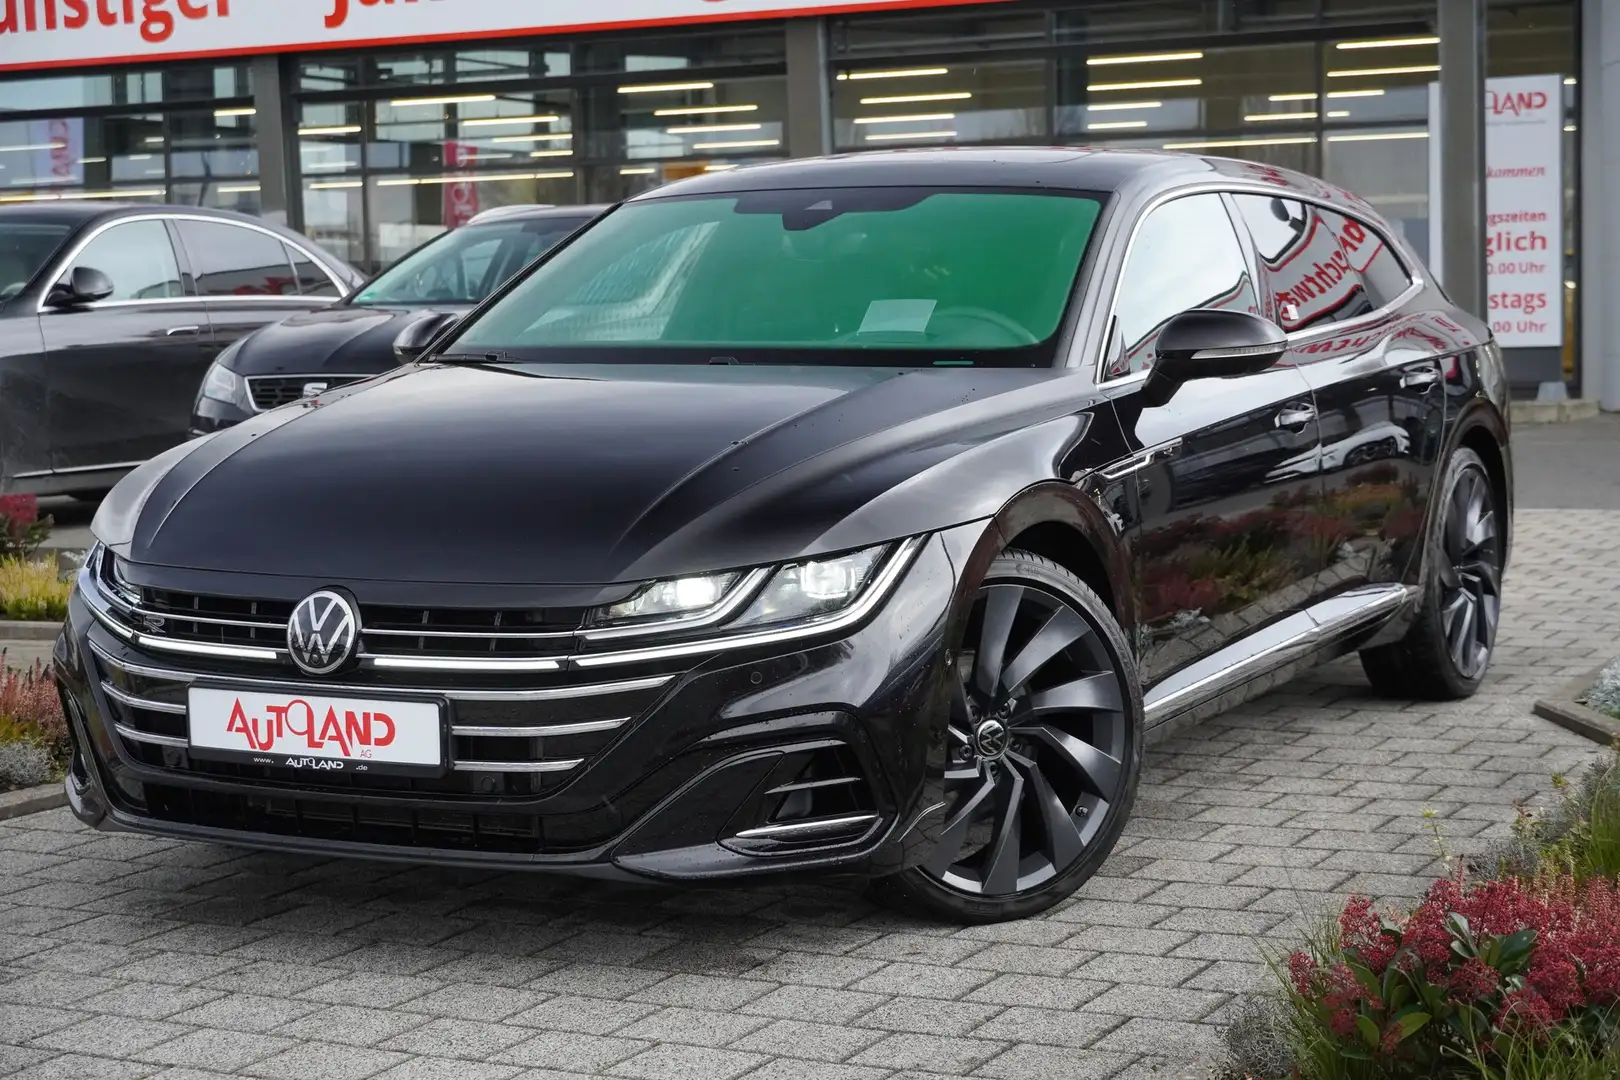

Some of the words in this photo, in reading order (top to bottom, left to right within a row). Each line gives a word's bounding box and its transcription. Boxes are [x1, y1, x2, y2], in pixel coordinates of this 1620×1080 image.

[1519, 261, 1547, 274] Uhr
[1487, 292, 1547, 315] stags
[1517, 320, 1547, 333] Uhr
[226, 697, 396, 757] AUTOLAND
[359, 749, 372, 759] AG
[285, 757, 344, 770] AUTOLAND
